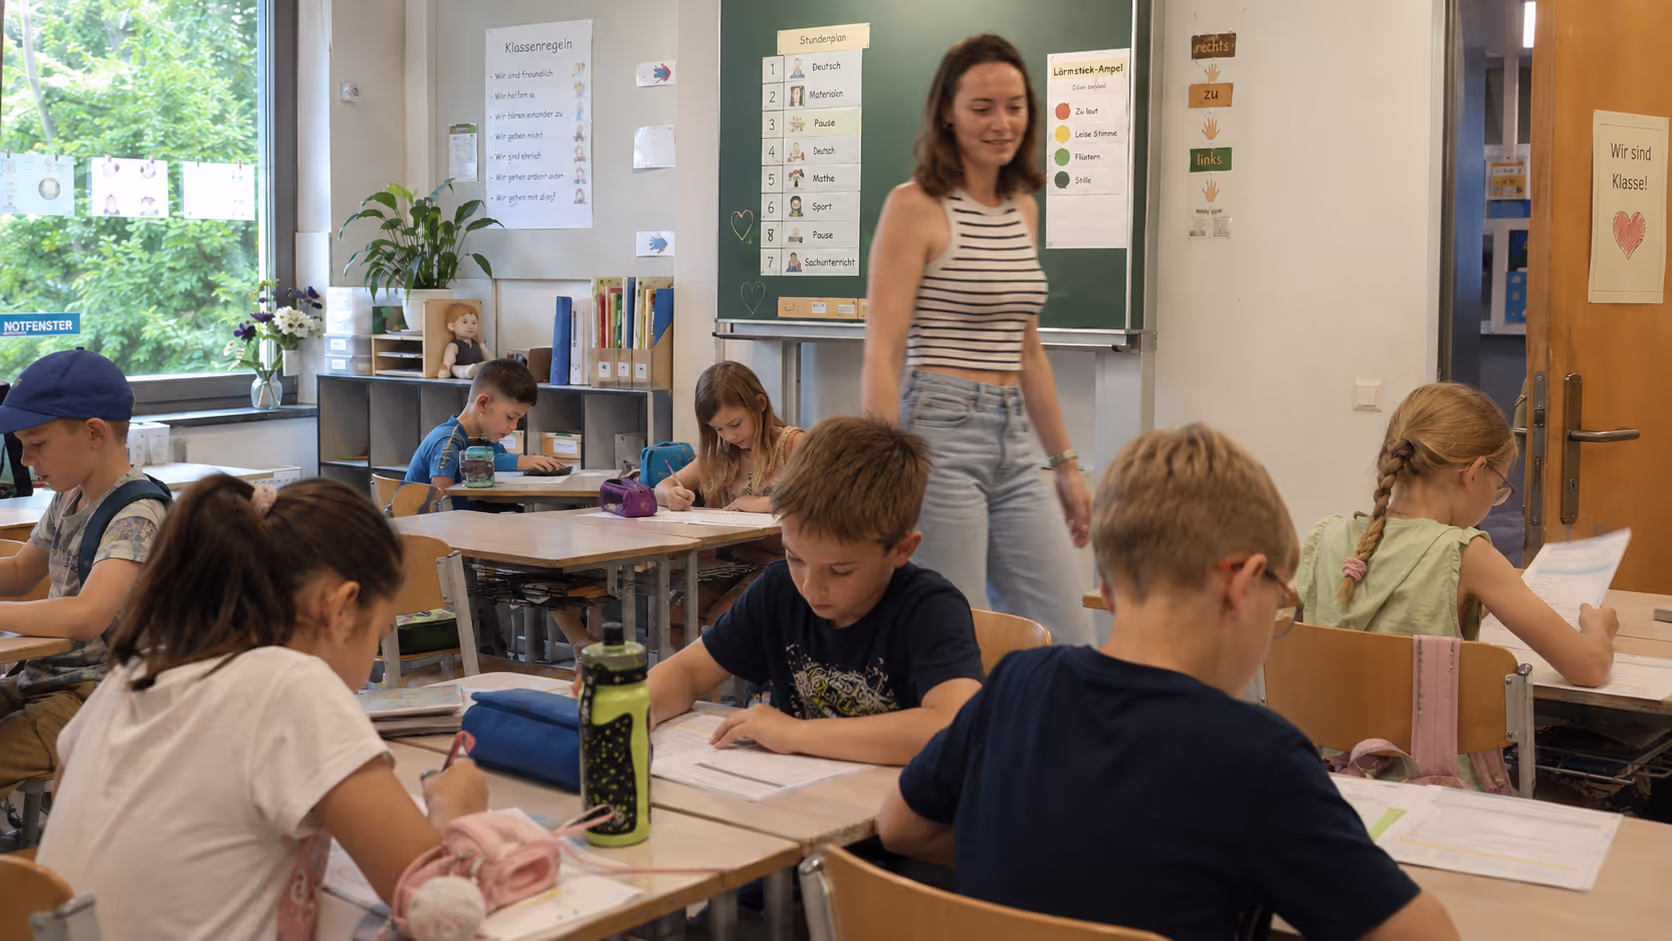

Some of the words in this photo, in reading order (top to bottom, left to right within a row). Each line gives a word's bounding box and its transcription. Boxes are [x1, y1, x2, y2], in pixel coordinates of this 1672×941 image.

[800, 34, 846, 45] Stundenplan
[505, 38, 572, 54] Klassenregeln
[1195, 38, 1229, 53] rechts
[770, 64, 775, 75] 1
[812, 62, 840, 71] Deutsch
[770, 91, 776, 103] 2
[1204, 90, 1219, 100] zu
[769, 119, 775, 130] 3
[814, 119, 836, 127] Pause
[768, 146, 775, 157] 4
[813, 146, 836, 155] Deutsch
[1610, 142, 1628, 160] Wir
[1631, 146, 1652, 161] sind
[1197, 152, 1222, 166] links
[768, 174, 775, 186] 5
[813, 174, 835, 182] Mathe
[1612, 173, 1648, 190] Klasse!
[768, 201, 774, 213] 6
[812, 202, 832, 212] Sport
[768, 228, 774, 242] 8
[813, 230, 833, 239] Pause
[768, 256, 774, 268] 7
[4, 320, 73, 332] NOTFENSTER
